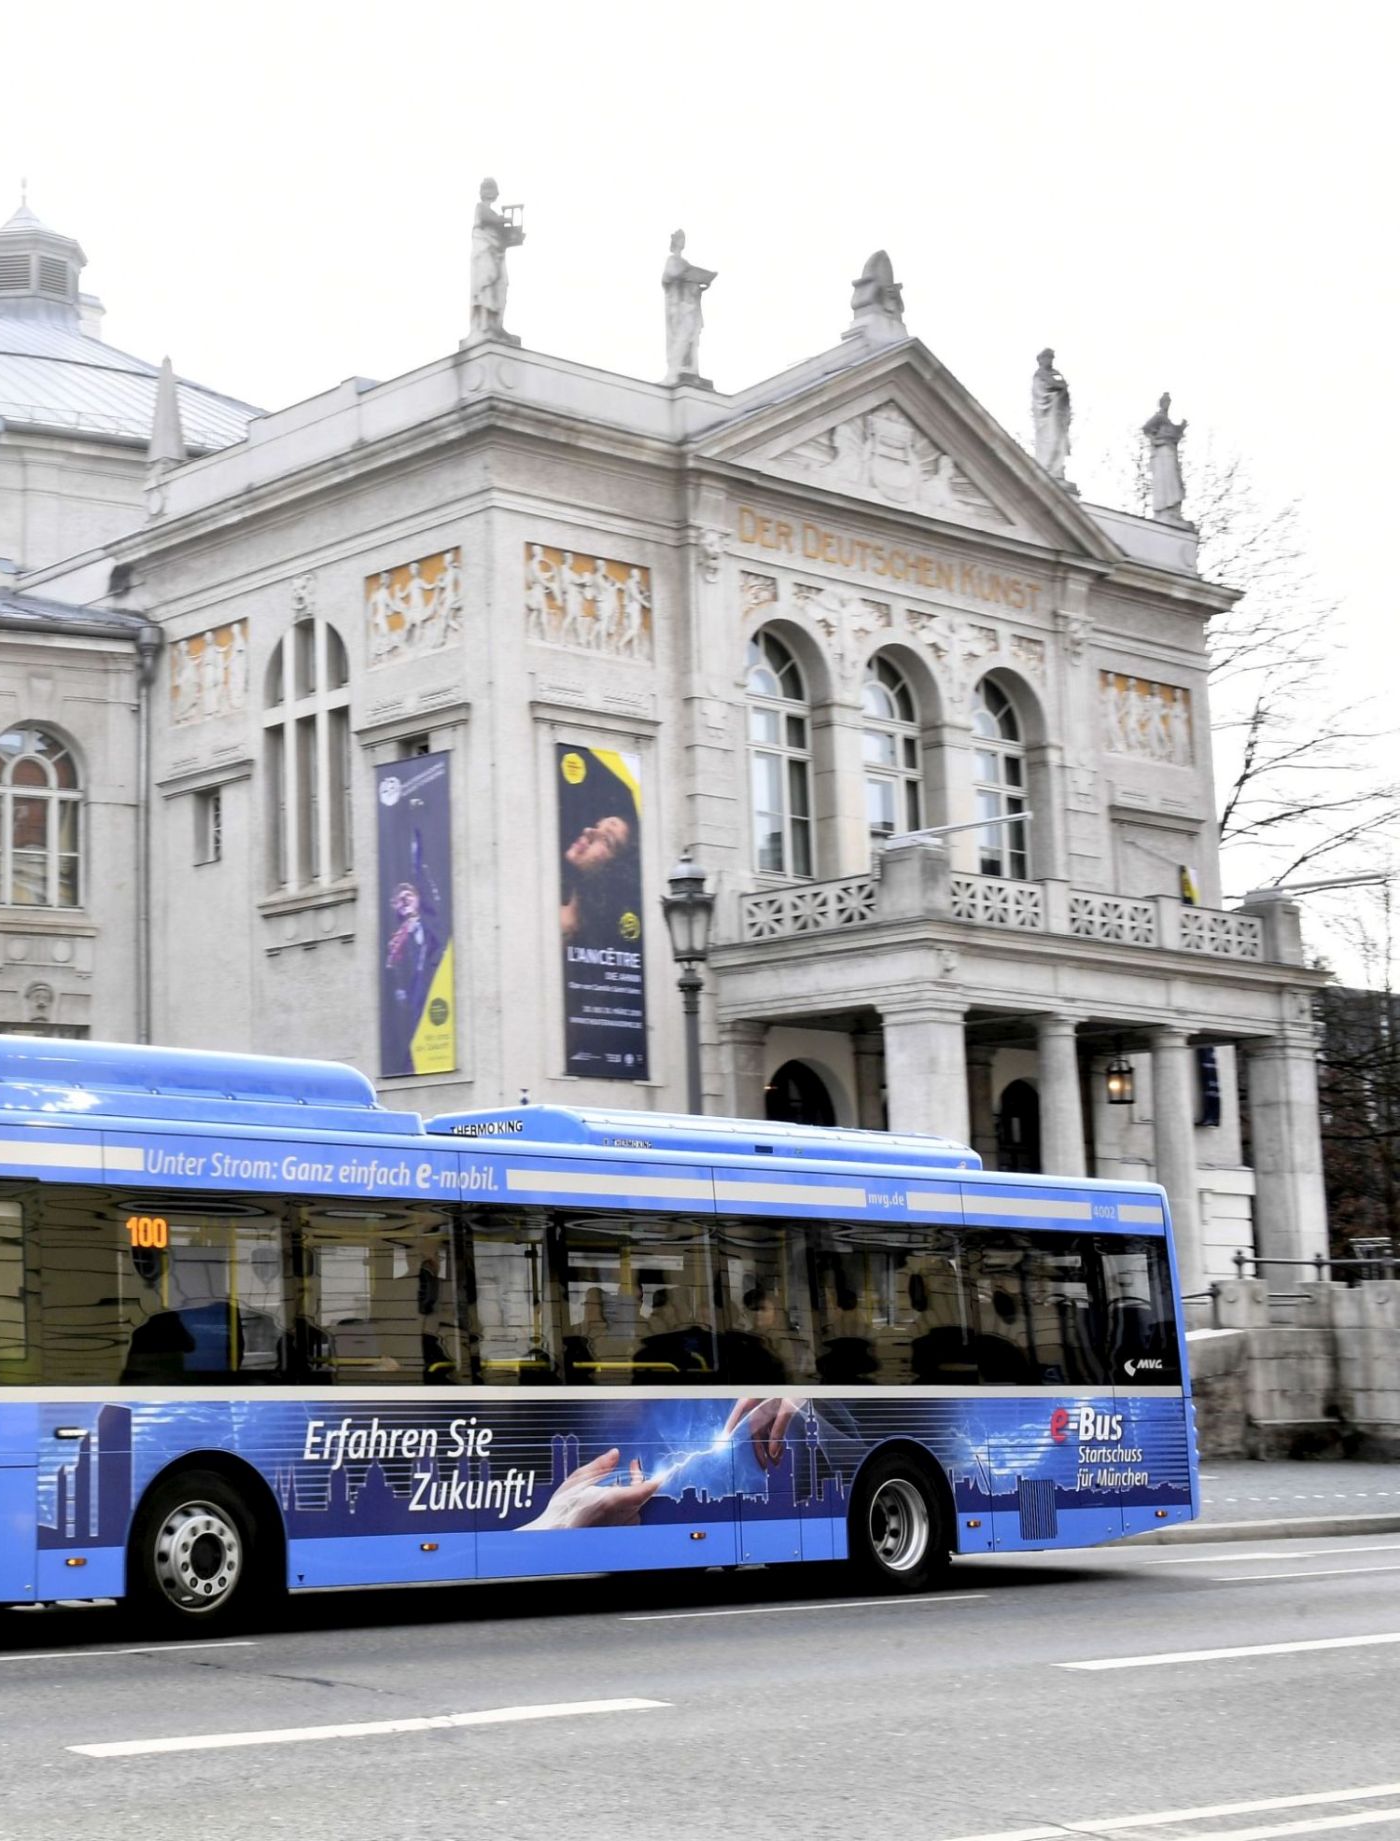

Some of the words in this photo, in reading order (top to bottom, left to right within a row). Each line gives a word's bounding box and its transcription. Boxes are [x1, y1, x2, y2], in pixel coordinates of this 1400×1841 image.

[738, 505, 793, 553] DER
[801, 522, 955, 593] DEUTSCHEN
[958, 560, 1043, 612] KUNST
[567, 946, 641, 968] L'ANCÊTRE
[450, 1121, 495, 1136] THERMO
[497, 1119, 523, 1134] KING
[148, 1149, 206, 1178] Unter
[210, 1152, 277, 1180] Strom:
[281, 1156, 334, 1182] Ganz
[339, 1158, 410, 1191] einfach
[415, 1162, 499, 1191] e-mobil.
[868, 1192, 905, 1209] mvg.de
[1093, 1207, 1116, 1220] 4002
[126, 1216, 168, 1248] 100
[1137, 1359, 1163, 1369] MVG
[1050, 1406, 1123, 1443] e-Bus
[303, 1417, 438, 1470] Erfahren
[447, 1417, 493, 1458] Sie
[1078, 1444, 1143, 1464] Startschuss
[1076, 1467, 1094, 1492] für
[1096, 1468, 1148, 1487] München
[408, 1468, 536, 1519] Zukunft!
